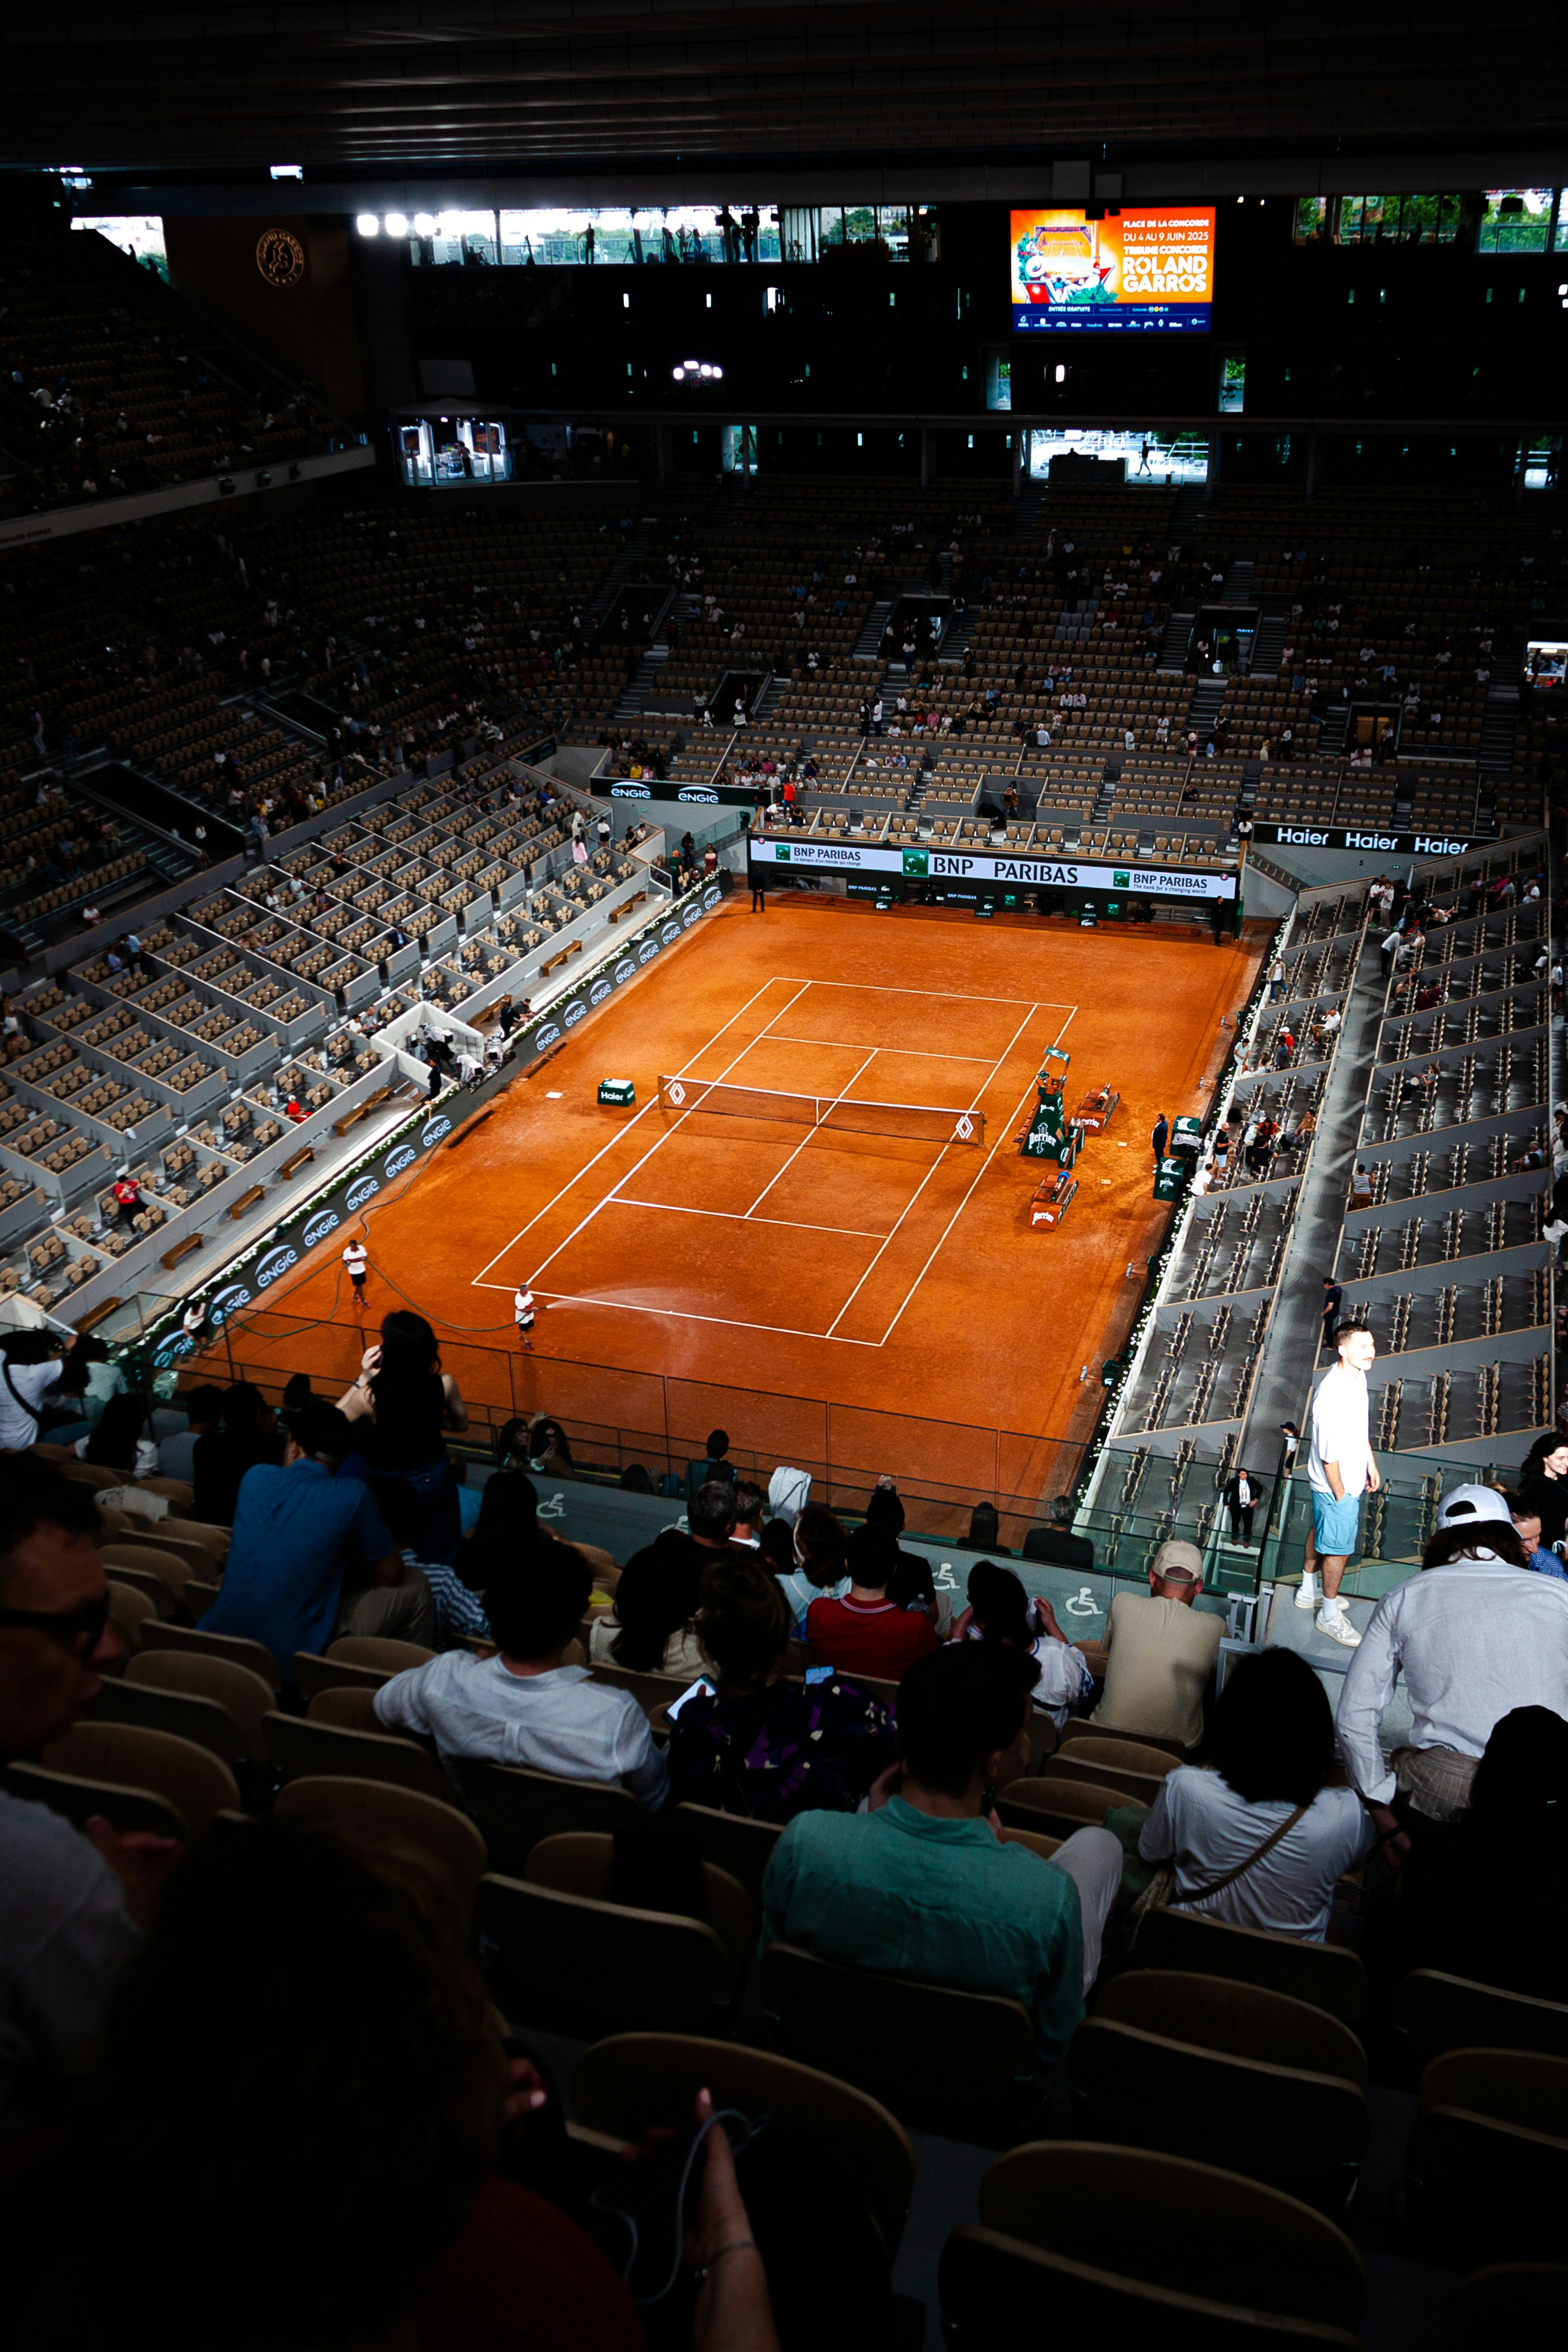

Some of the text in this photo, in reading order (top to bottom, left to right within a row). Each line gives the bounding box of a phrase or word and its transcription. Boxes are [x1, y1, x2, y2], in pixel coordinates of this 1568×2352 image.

[1123, 231, 1209, 242] DU 4 AU 9 JUIN 2025
[1123, 245, 1208, 255] TRIBUNE CONCORDE
[1122, 255, 1208, 275] ROLAND
[1122, 273, 1207, 293] GARROS
[1277, 828, 1329, 845] Haier
[1345, 832, 1398, 850] Haier
[794, 847, 861, 861] BNP PARIBAS
[1414, 837, 1468, 854] Haier
[933, 856, 1078, 884] BNP PARIBAS
[1133, 874, 1207, 888] BNP PARIBAS
[601, 1092, 624, 1101] Haier
